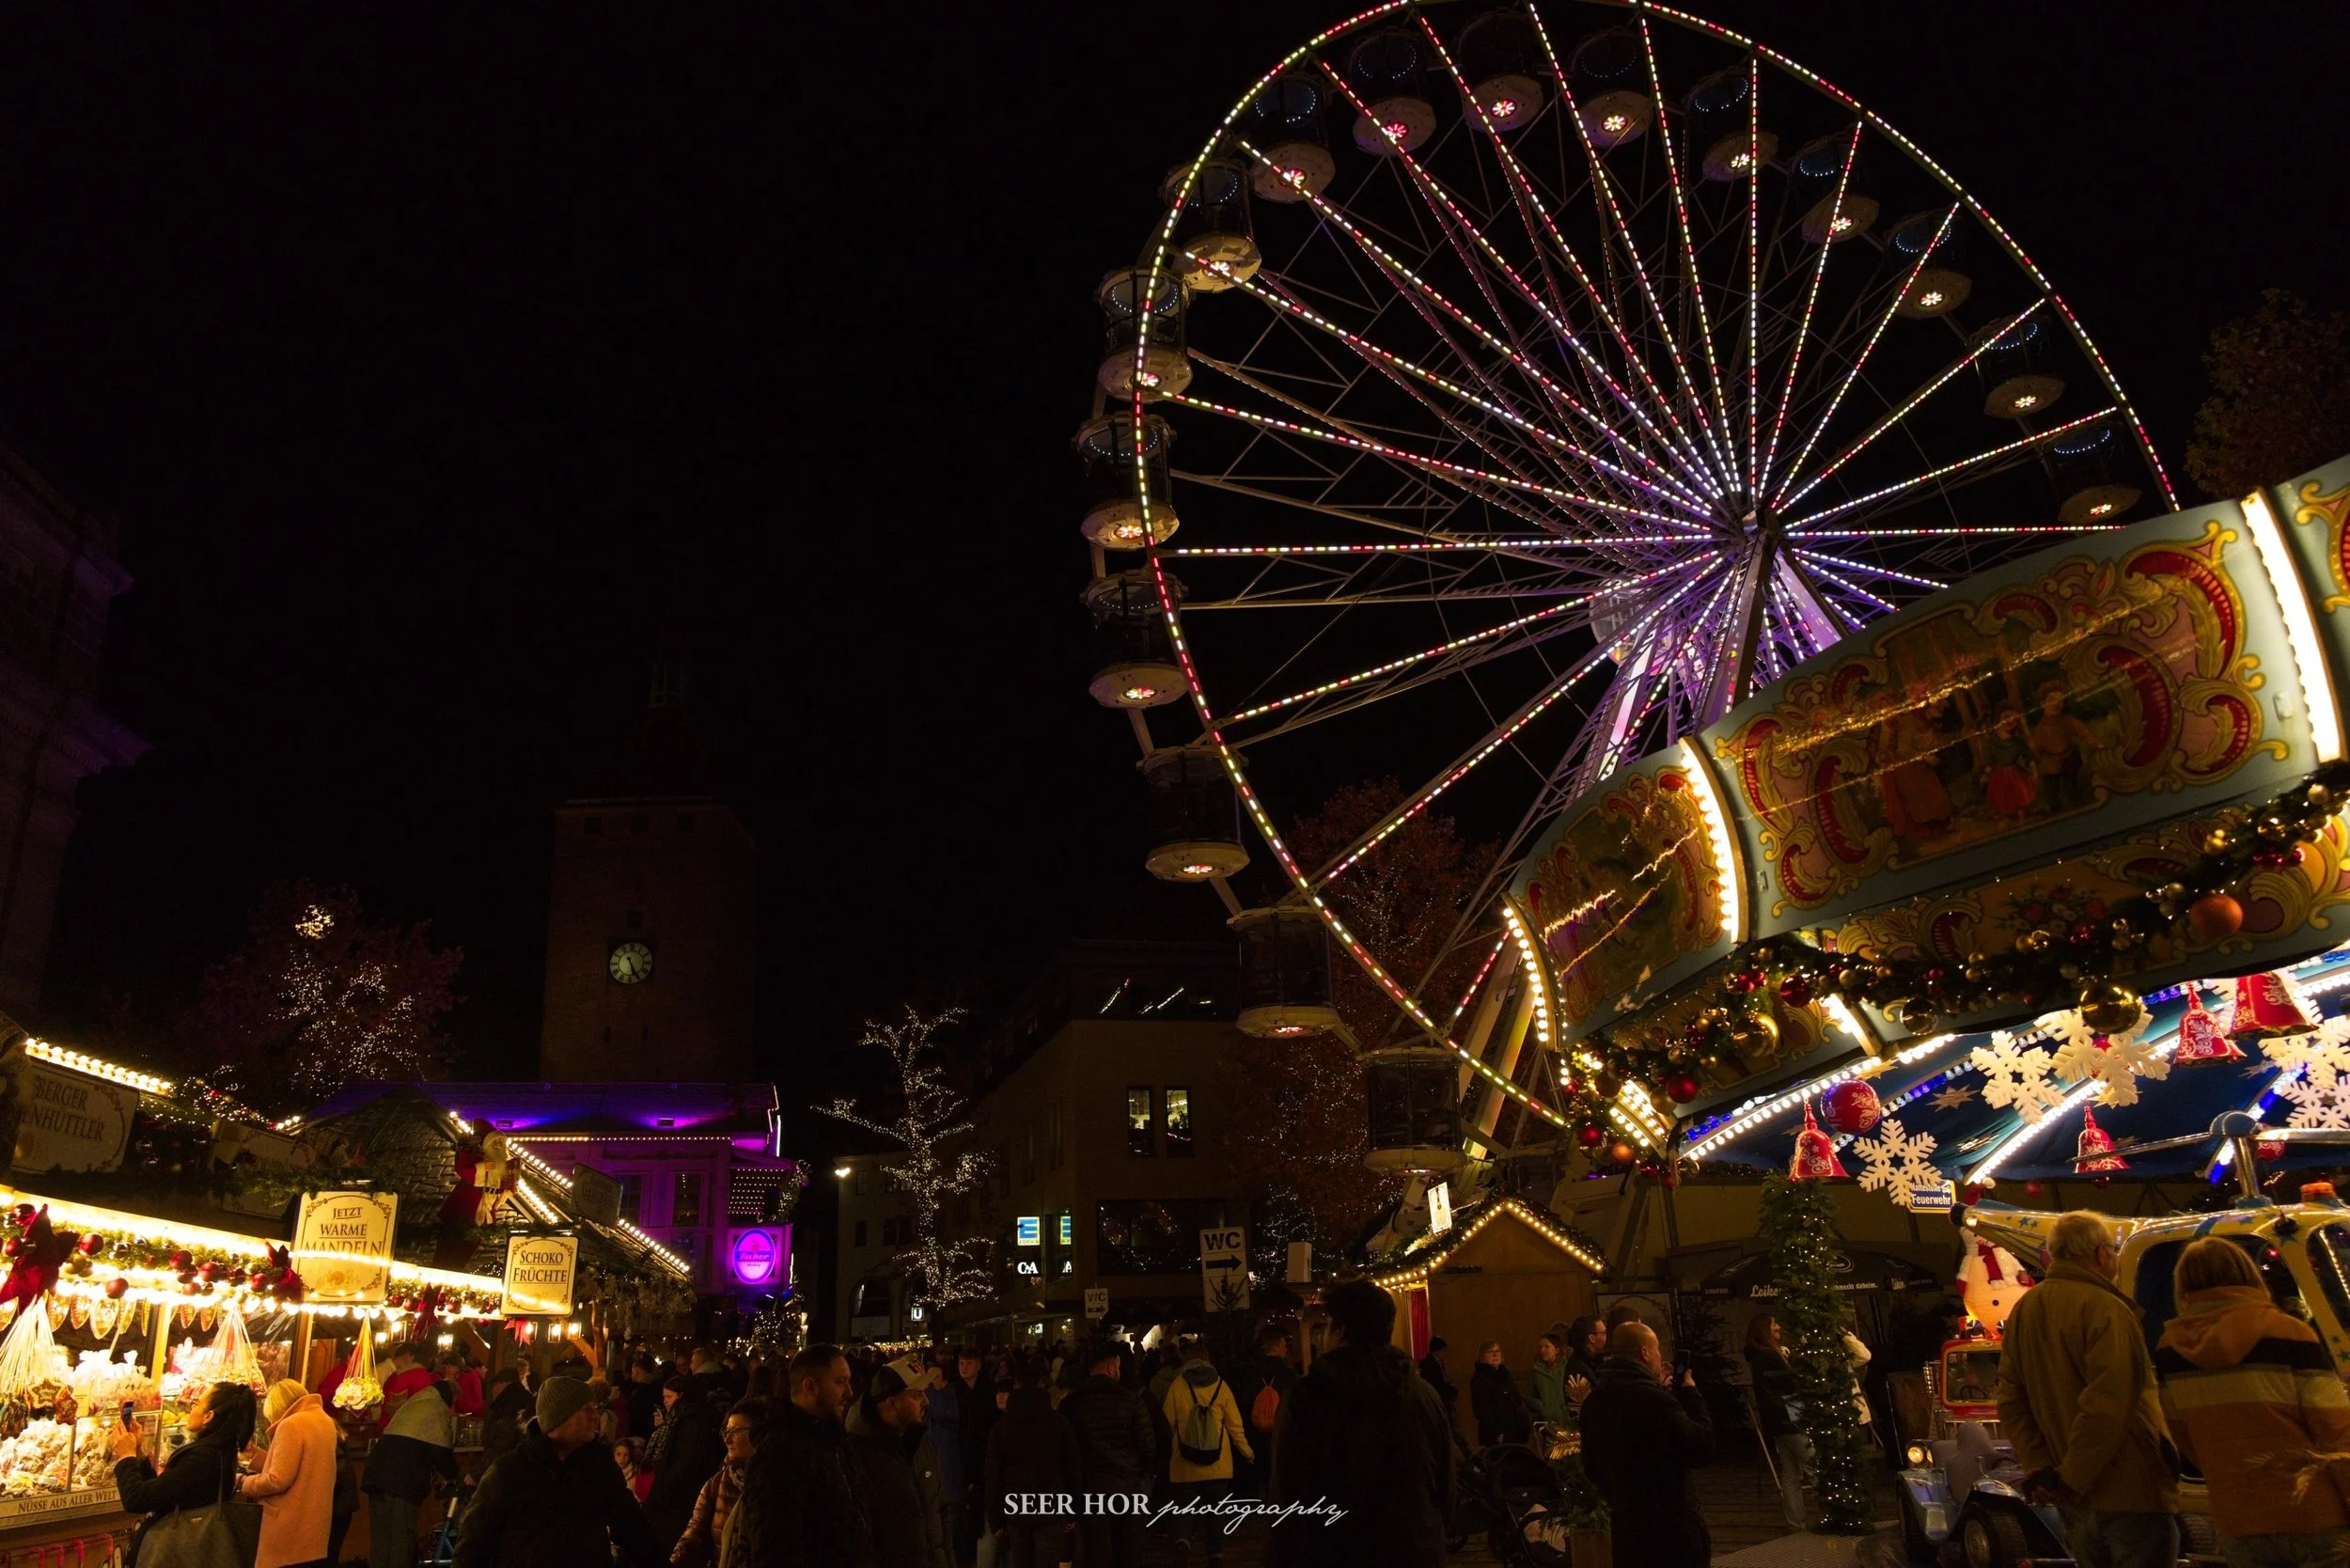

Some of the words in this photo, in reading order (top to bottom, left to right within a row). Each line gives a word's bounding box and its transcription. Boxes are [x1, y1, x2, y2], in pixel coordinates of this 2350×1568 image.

[35, 1075, 88, 1109] BERGER
[1912, 1194, 1951, 1205] Feuerwehr
[333, 1207, 363, 1219] JETZT
[321, 1224, 368, 1236] WARME
[1204, 1232, 1241, 1250] WC
[520, 1250, 564, 1263] SCHOKO
[512, 1266, 568, 1282] FRÜCHTE
[1087, 1293, 1106, 1302] WC
[914, 1309, 922, 1320] U
[18, 1499, 48, 1513] NÜSSE
[50, 1497, 68, 1509] AUS
[70, 1494, 93, 1506] ALLER
[95, 1490, 117, 1502] WELT
